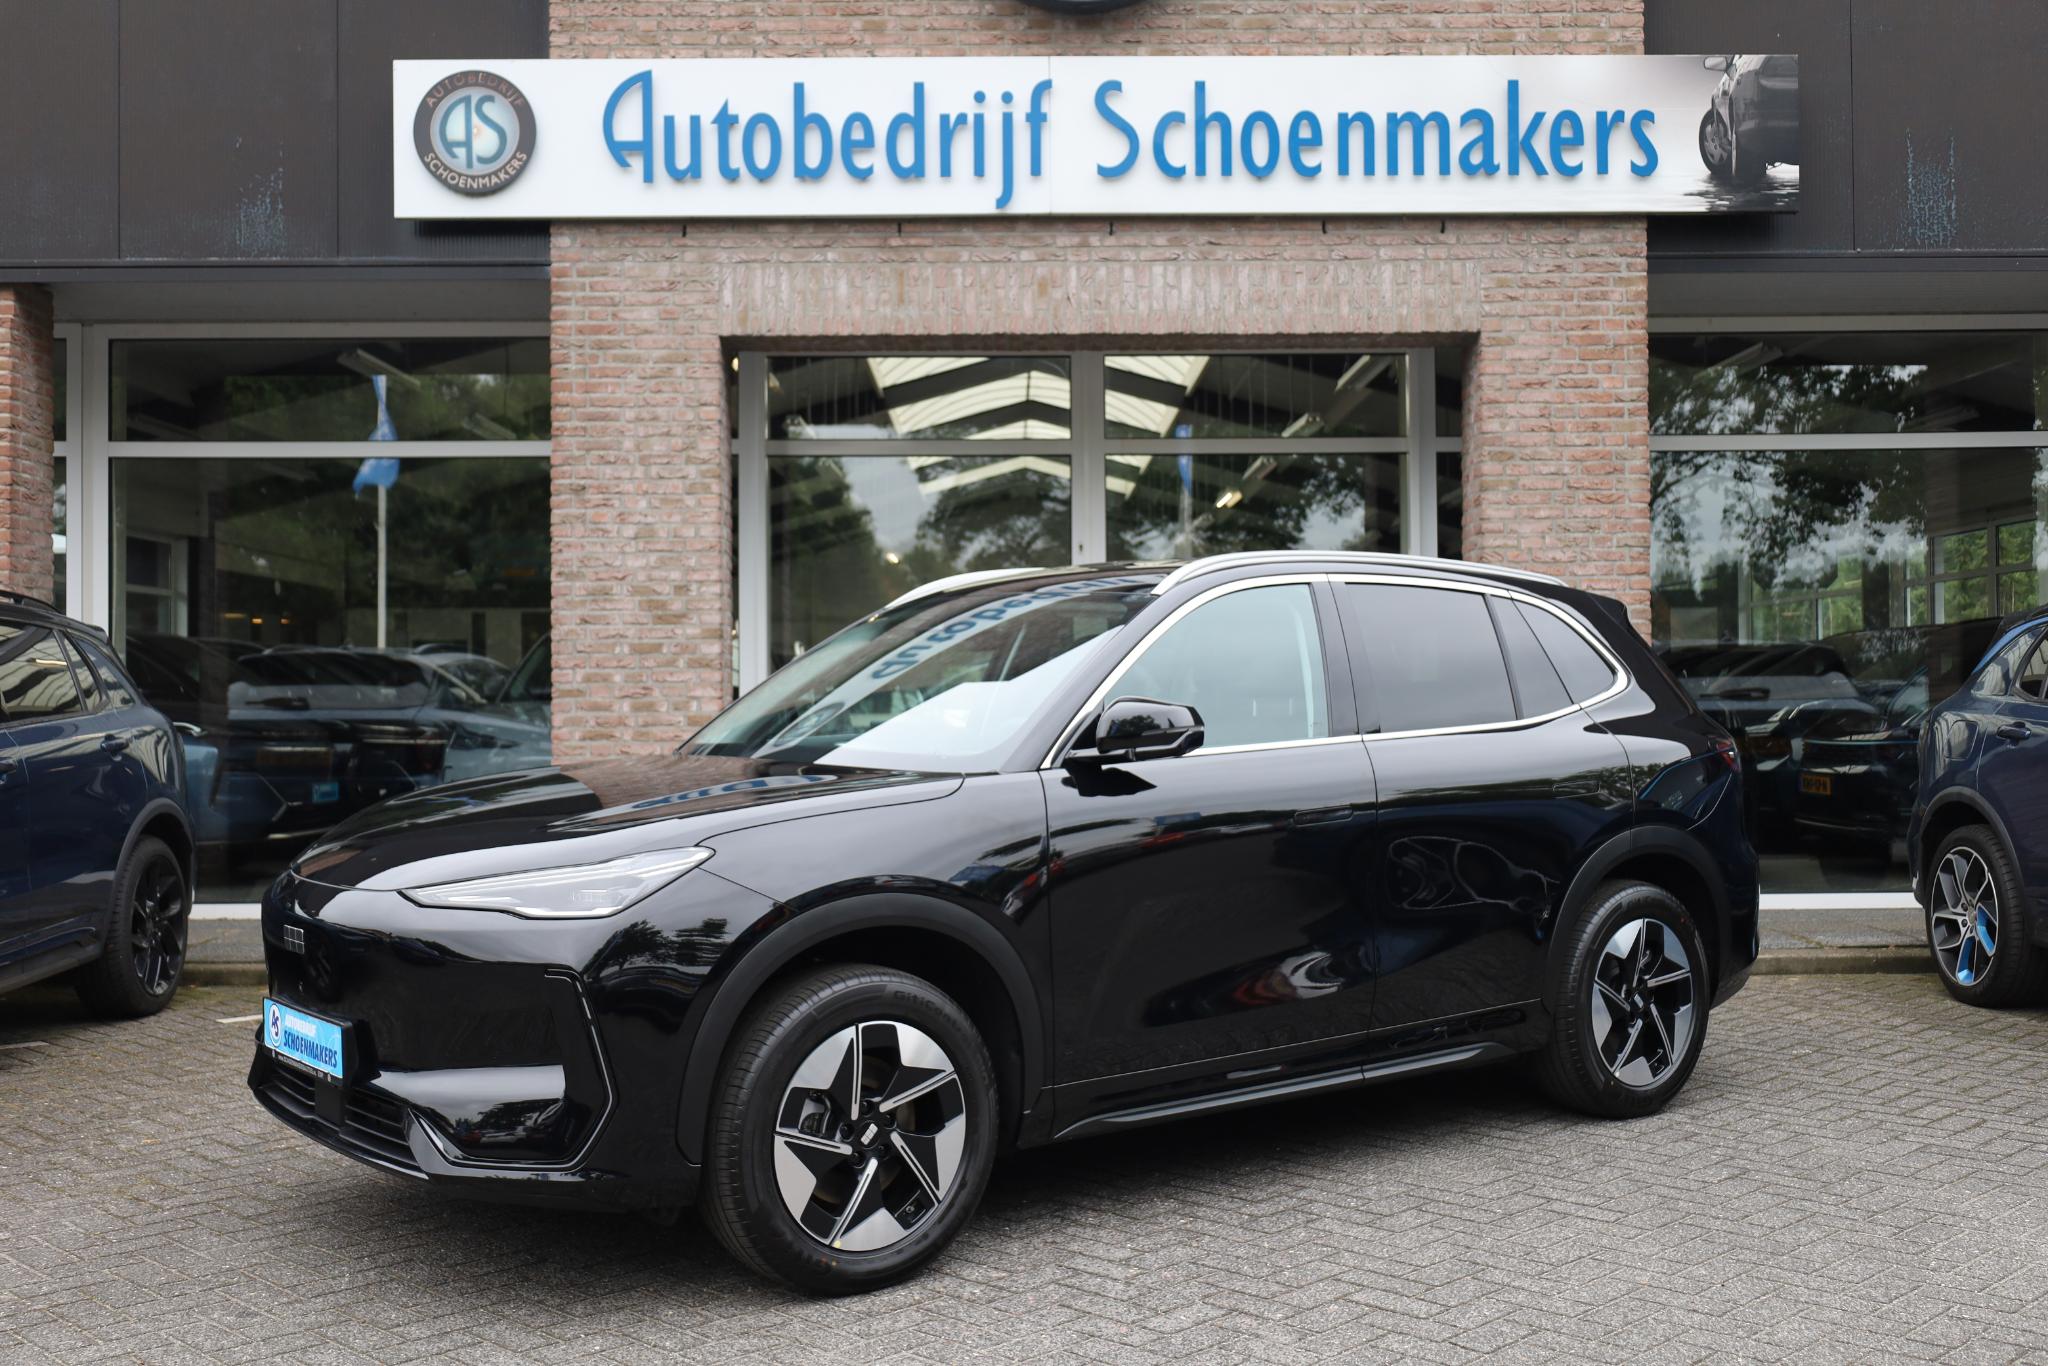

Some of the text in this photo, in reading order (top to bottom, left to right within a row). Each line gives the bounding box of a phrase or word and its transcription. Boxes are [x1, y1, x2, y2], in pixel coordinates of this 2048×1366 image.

[426, 72, 523, 108] AUTOBEDRIJF
[438, 94, 508, 170] AS
[601, 69, 1660, 210] Autobedrijf Schoenmakers
[424, 151, 528, 190] SCHOENMAKERS
[283, 1030, 338, 1068] SCHOENMAKERS
